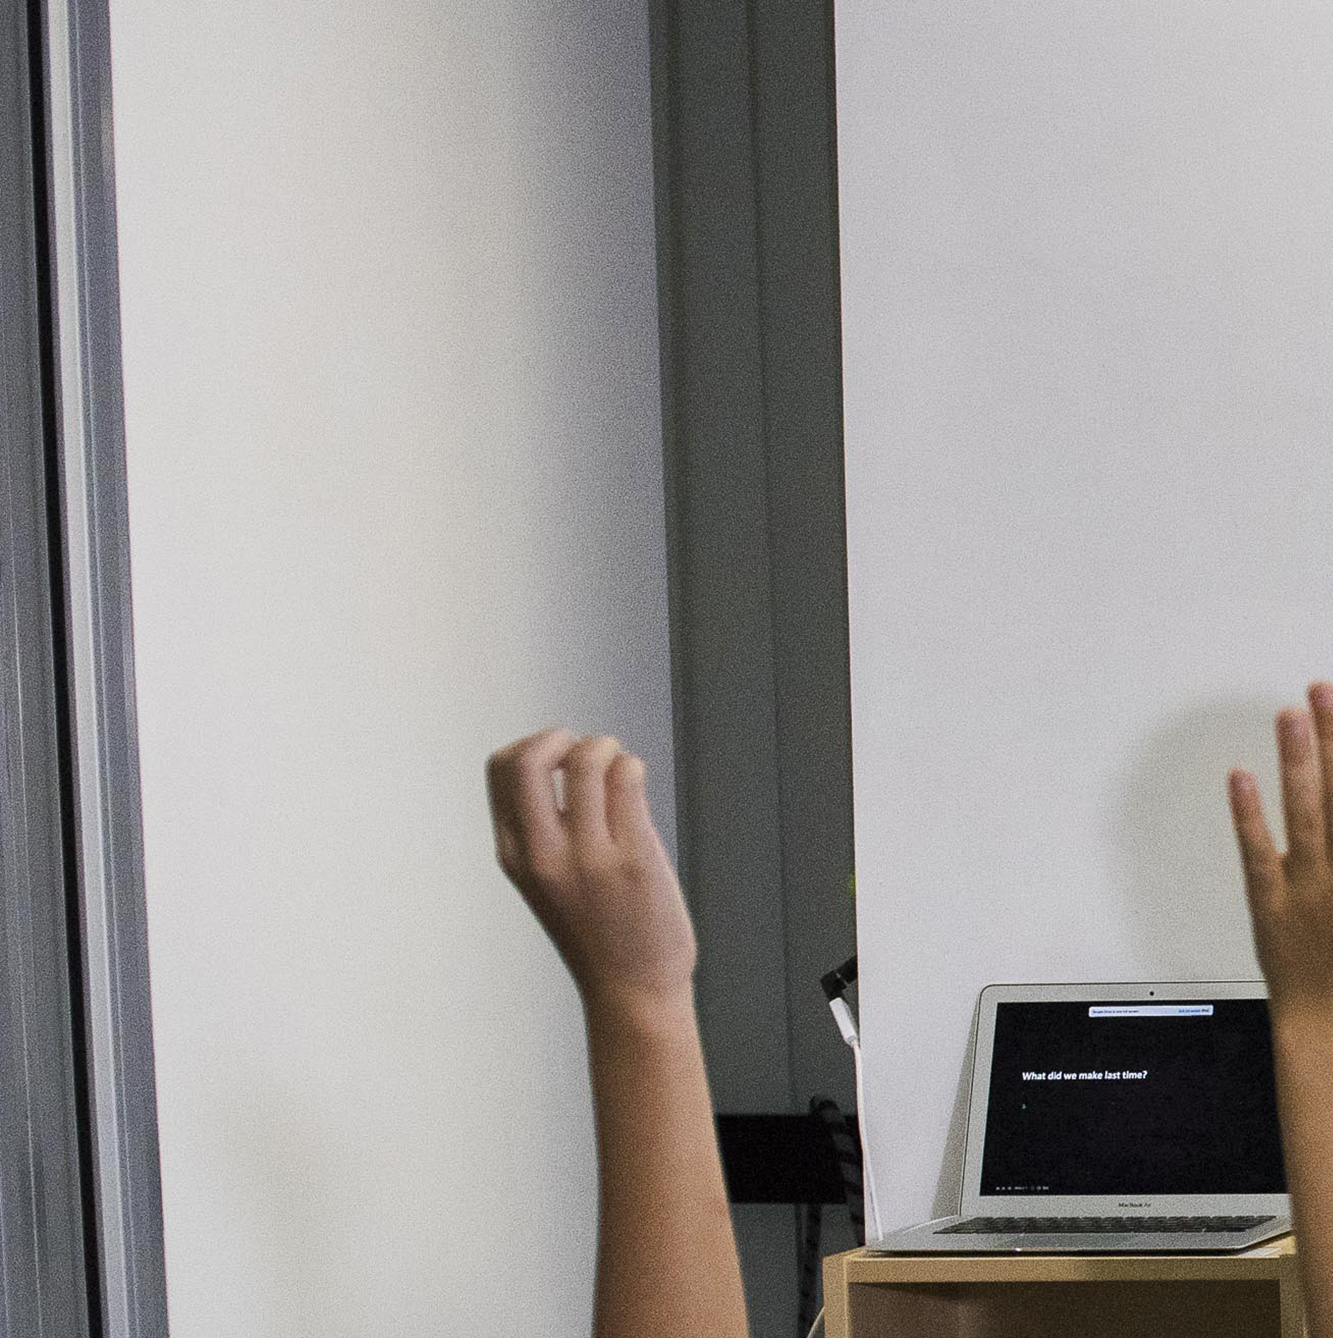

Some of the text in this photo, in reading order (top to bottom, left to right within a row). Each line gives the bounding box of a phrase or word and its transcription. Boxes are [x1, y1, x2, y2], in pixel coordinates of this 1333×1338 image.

[1022, 1071, 1046, 1081] What
[1047, 1071, 1063, 1080] did
[1078, 1070, 1104, 1080] make
[1104, 1070, 1121, 1080] last
[1122, 1070, 1148, 1080] time?
